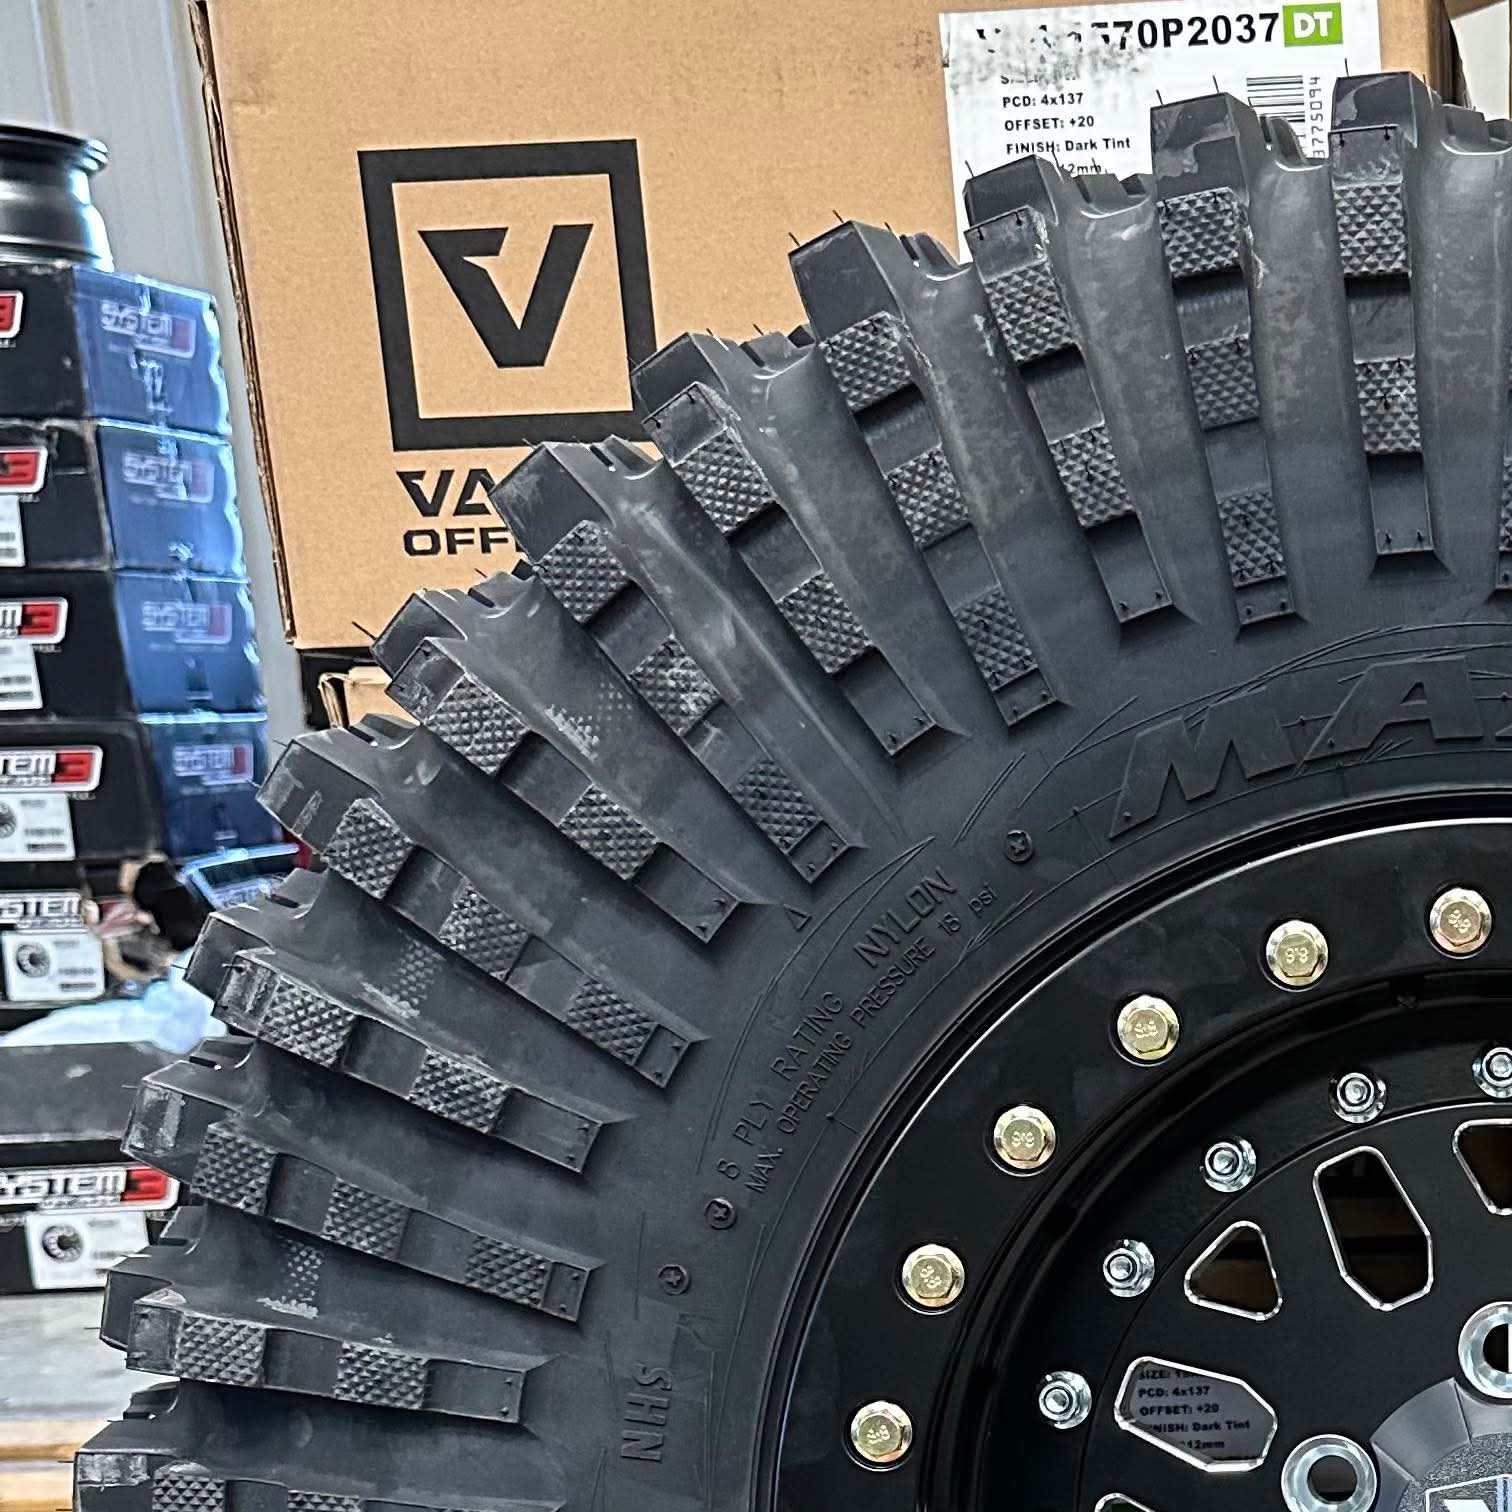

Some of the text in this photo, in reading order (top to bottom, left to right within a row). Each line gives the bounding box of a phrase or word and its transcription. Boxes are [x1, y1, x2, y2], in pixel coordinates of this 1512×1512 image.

[1292, 11, 1333, 39] DT
[1002, 92, 1084, 108] PCD: 4x137
[1004, 115, 1095, 131] OFFSET: +20
[1006, 137, 1131, 155] FINISH: Dark Tint
[403, 527, 523, 557] OFF
[734, 1088, 777, 1146] PLY
[770, 989, 844, 1082] RATING
[853, 866, 958, 969] NYLON
[780, 1031, 853, 1135] OPERATING
[849, 934, 937, 1027] PRESSURE
[1138, 1387, 1169, 1399] PCD:
[620, 1361, 674, 1463] NHS
[1139, 1405, 1193, 1416] OFFSET:
[1191, 1421, 1222, 1432] Dark
